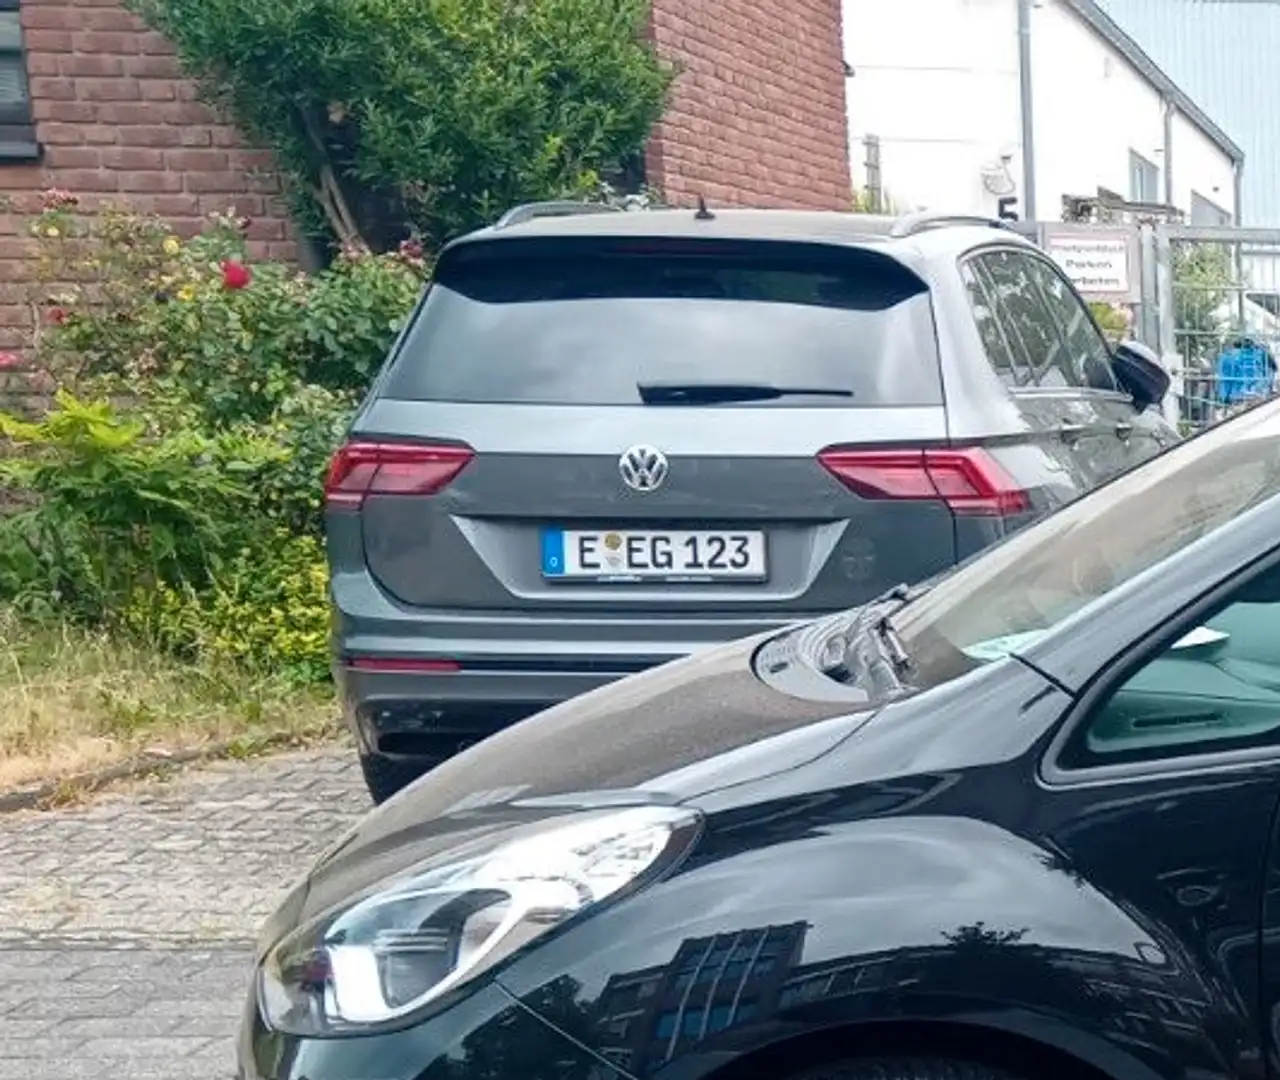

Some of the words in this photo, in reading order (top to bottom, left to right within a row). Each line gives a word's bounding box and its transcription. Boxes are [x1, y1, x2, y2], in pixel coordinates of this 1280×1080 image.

[578, 536, 599, 568] E
[627, 536, 673, 568] EG
[684, 536, 749, 568] 123
